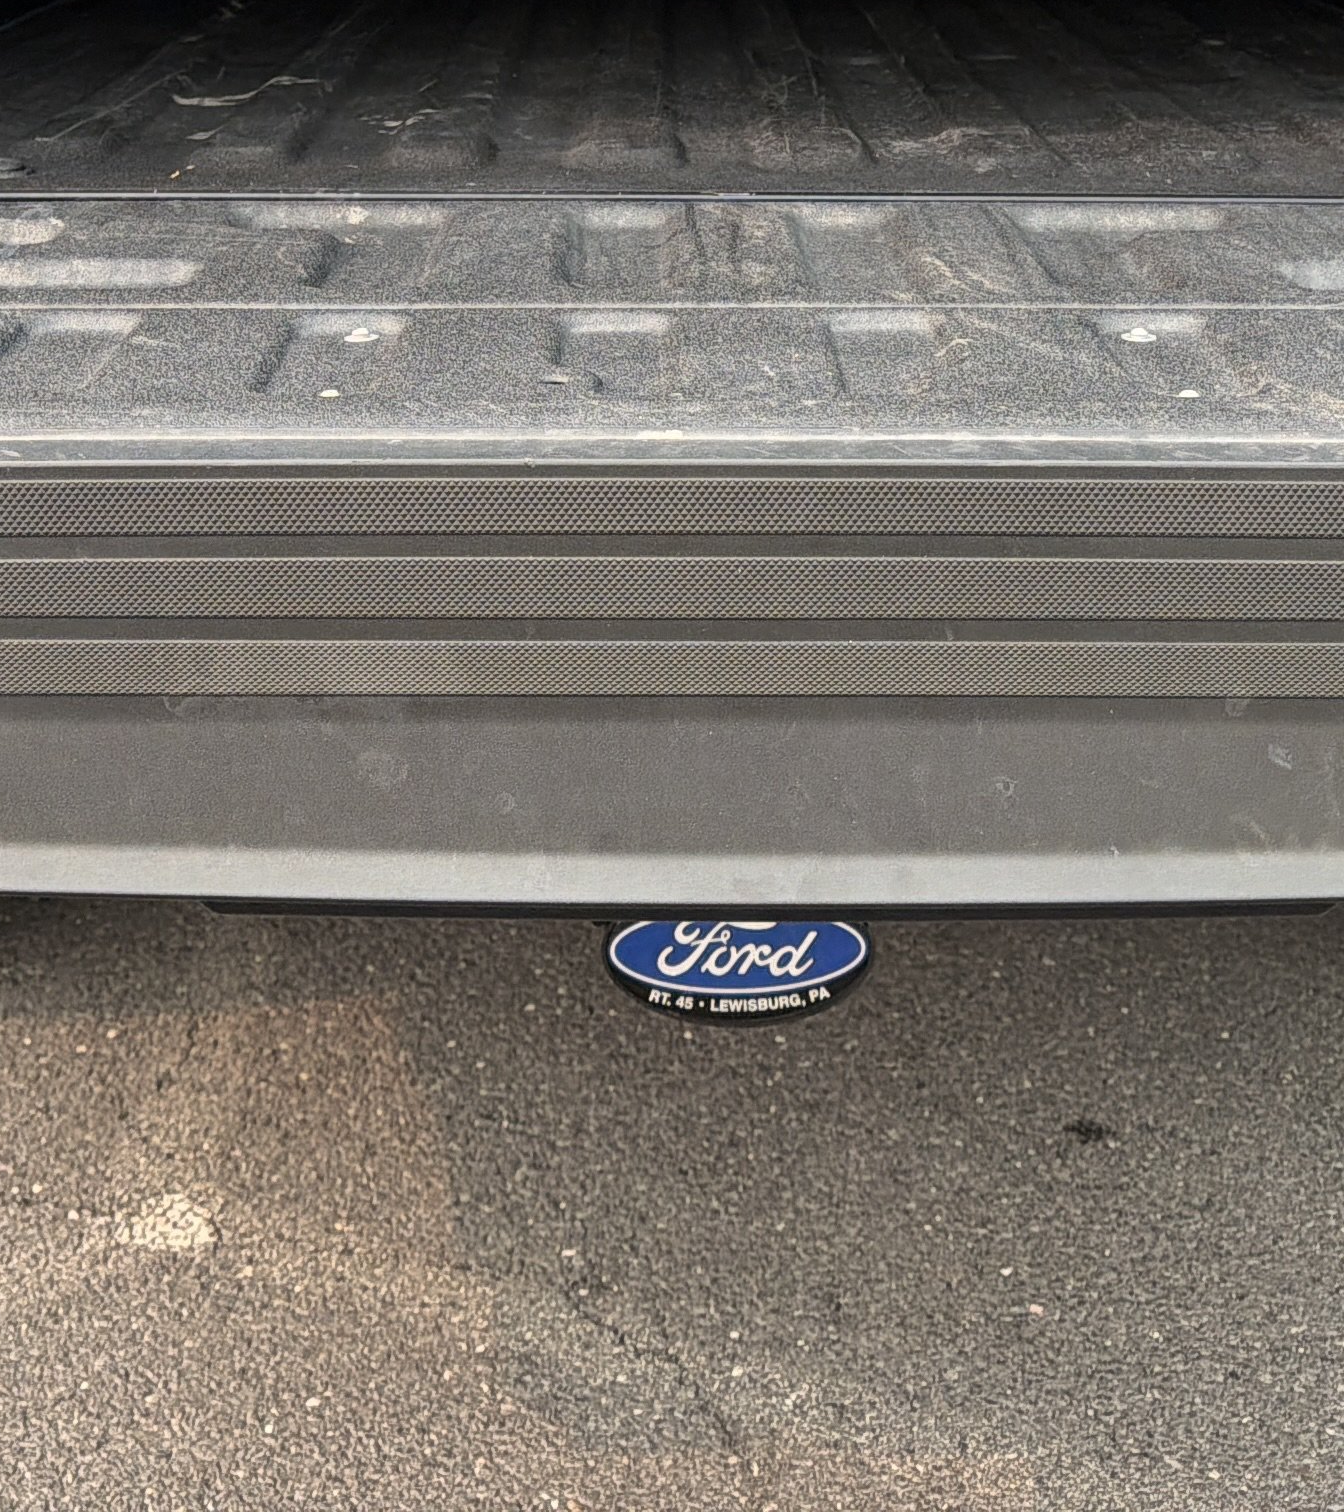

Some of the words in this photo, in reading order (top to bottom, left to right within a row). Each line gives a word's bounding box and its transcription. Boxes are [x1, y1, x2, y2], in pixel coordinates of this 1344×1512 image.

[657, 922, 817, 976] Ford
[649, 989, 671, 1006] RT.
[676, 996, 693, 1009] 45
[710, 993, 806, 1012] LEWISBURG,
[808, 986, 831, 1003] PA
